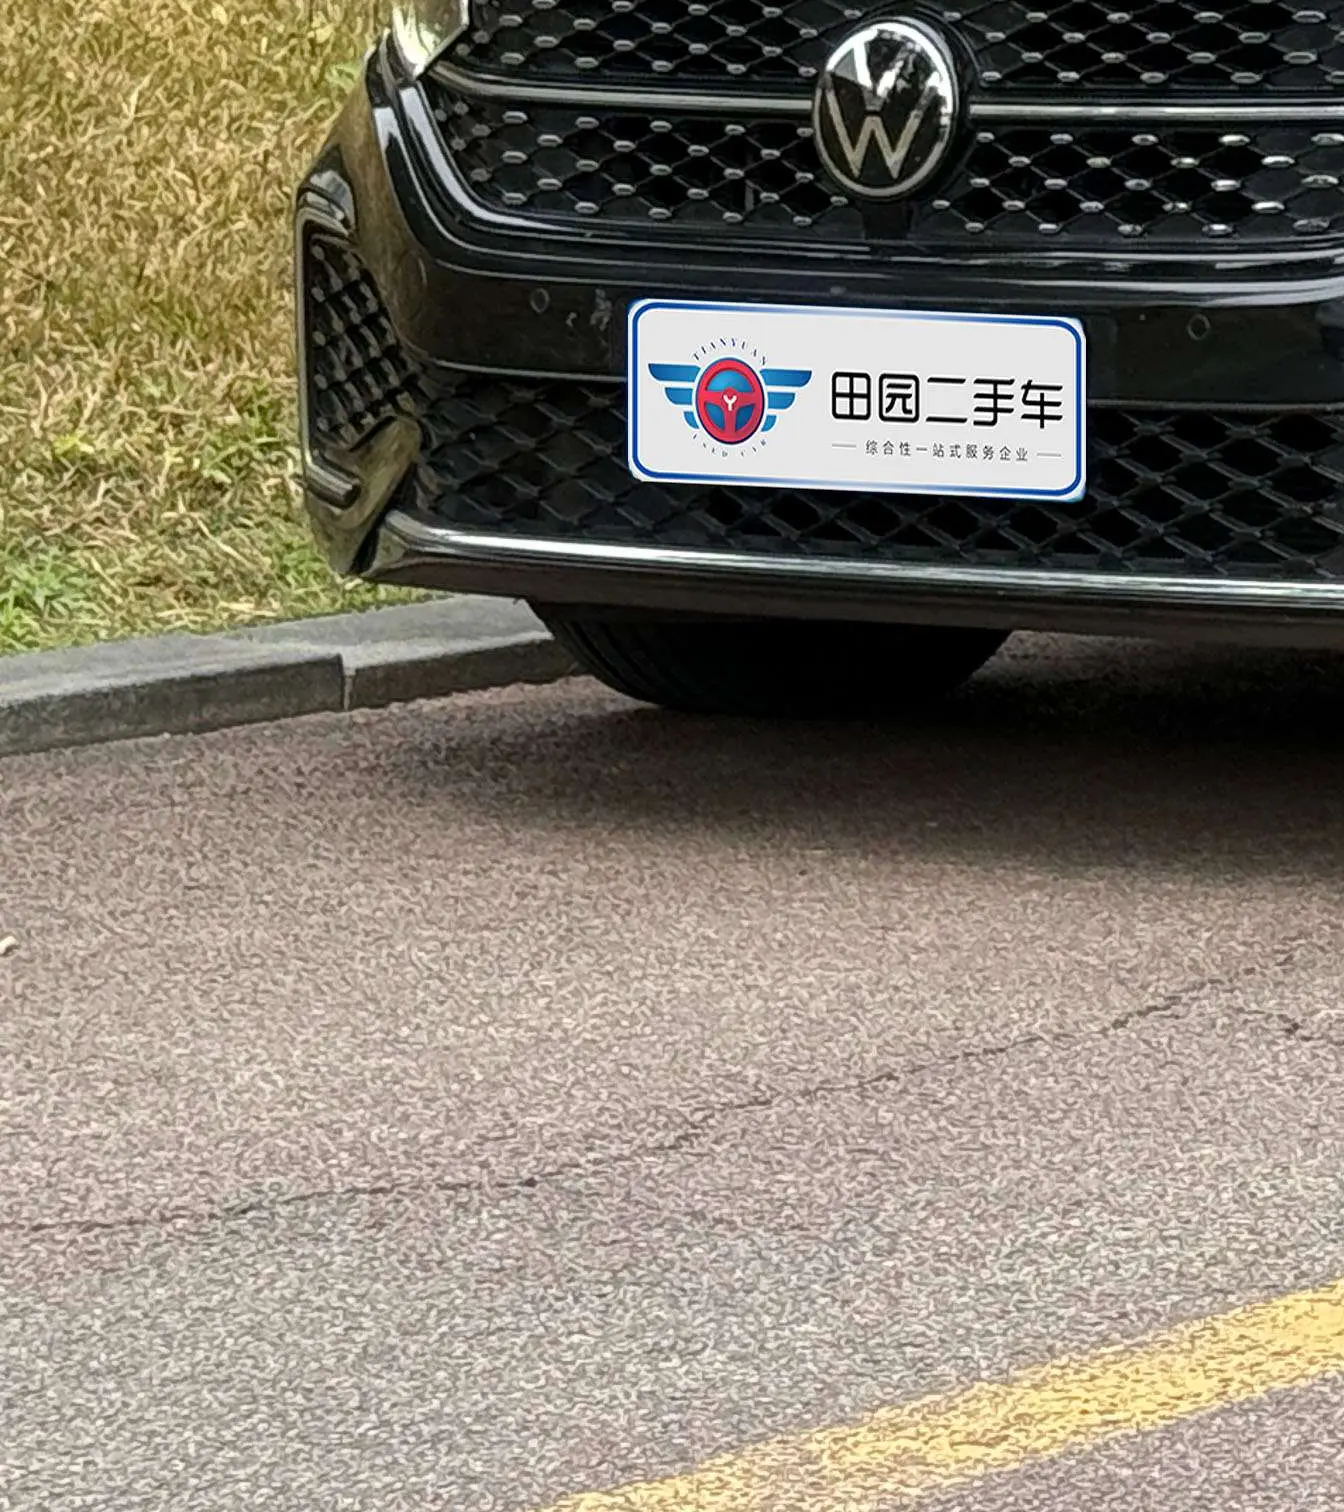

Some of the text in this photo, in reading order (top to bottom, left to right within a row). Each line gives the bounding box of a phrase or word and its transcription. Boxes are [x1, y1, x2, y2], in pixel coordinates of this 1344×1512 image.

[831, 371, 1063, 429] 田园二手车
[865, 439, 1028, 462] 综合性一站式服务企业
